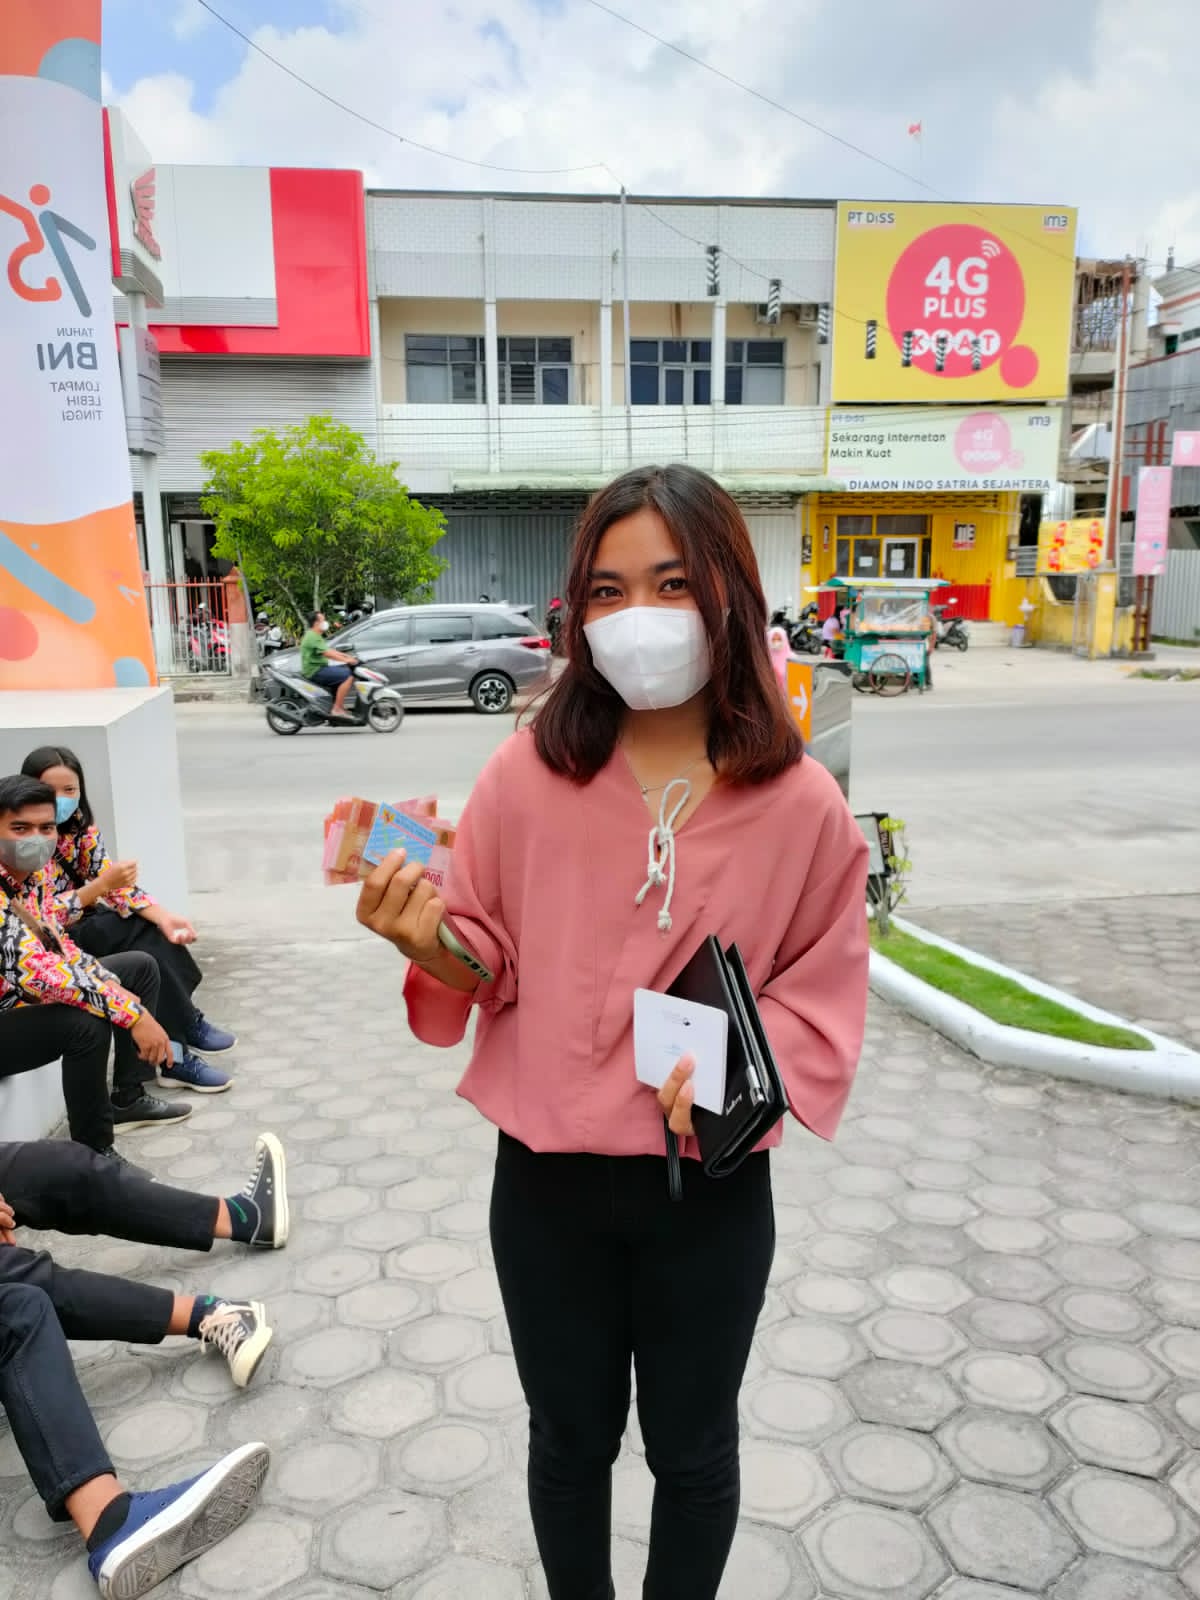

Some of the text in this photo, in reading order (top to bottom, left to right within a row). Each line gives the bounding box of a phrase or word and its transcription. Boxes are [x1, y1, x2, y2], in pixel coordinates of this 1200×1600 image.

[848, 211, 863, 223] PT
[925, 256, 988, 296] 4G
[923, 297, 987, 319] PLUS
[910, 332, 998, 353] KAT
[832, 432, 946, 444] Sekarang Internetan
[830, 448, 892, 458] Makin Kuat
[849, 479, 1051, 490] DIAMON INDO SATRIA SEJAHTERA
